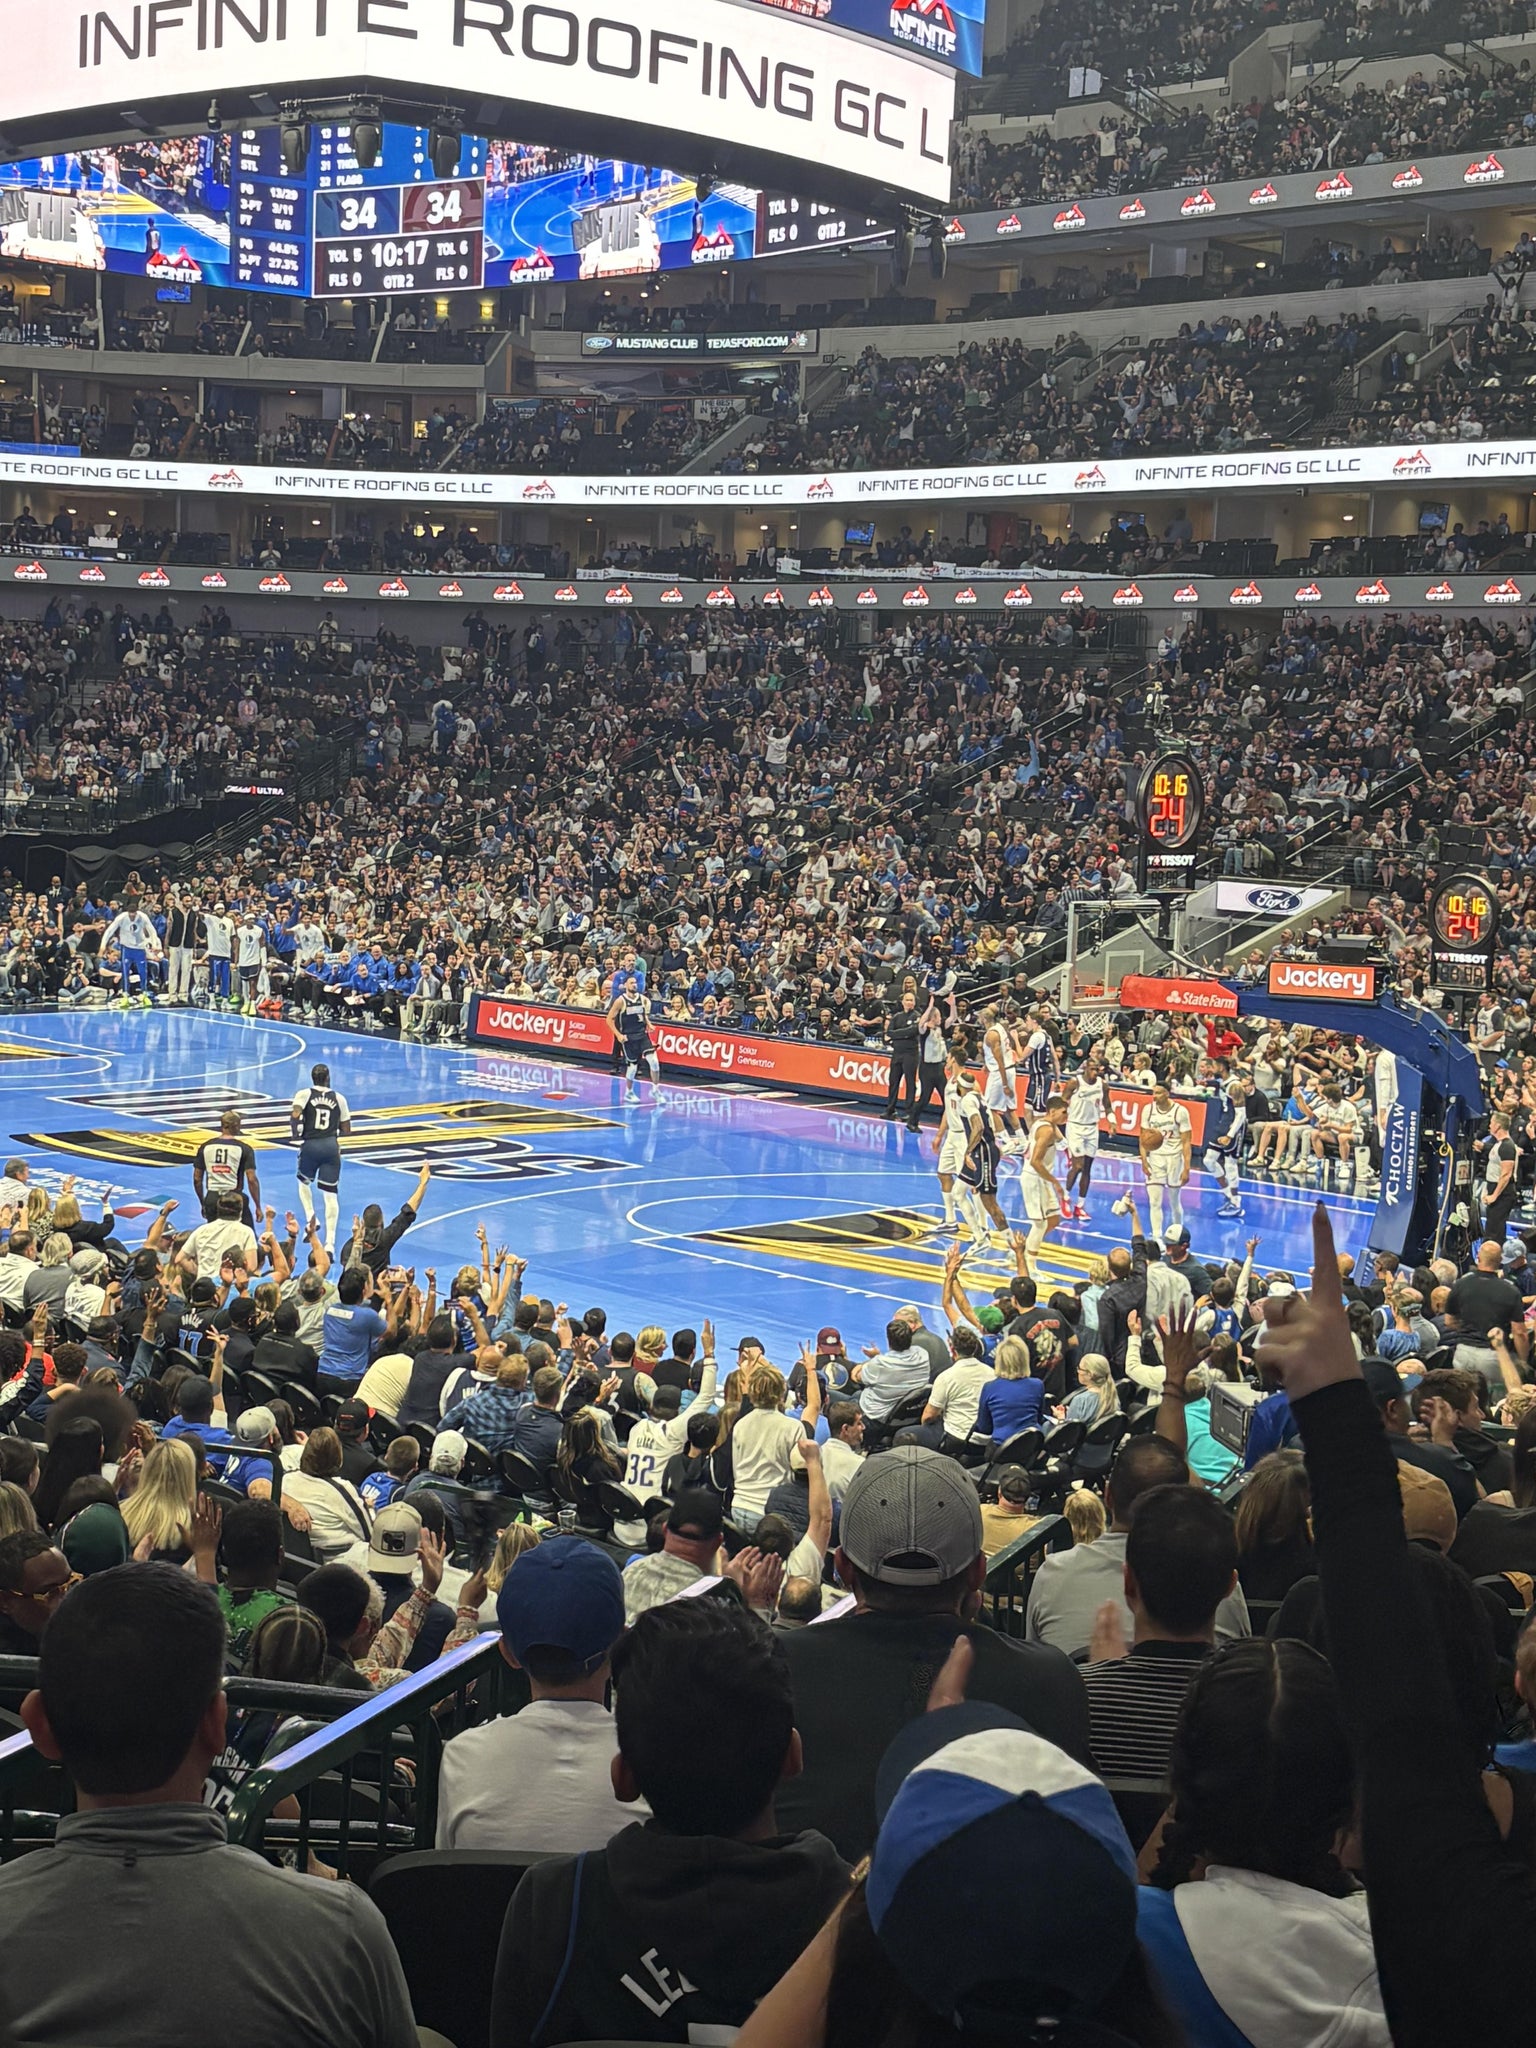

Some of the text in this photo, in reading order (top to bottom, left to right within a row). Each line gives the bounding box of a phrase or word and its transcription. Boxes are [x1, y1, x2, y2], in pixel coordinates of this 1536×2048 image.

[889, 8, 957, 52] INFINITE
[453, 0, 815, 122] ROOFING
[834, 79, 907, 150] GC
[240, 159, 259, 172] STL
[24, 190, 78, 243] THE
[340, 189, 463, 231] 34 34
[768, 199, 787, 217] TOL
[598, 200, 640, 253] THE
[767, 225, 787, 244] FLS
[788, 223, 798, 241] 0
[327, 238, 469, 268] TOL 5 10:17 TOL 6
[328, 272, 349, 288] FLS
[352, 271, 363, 287] 0
[435, 266, 455, 282] FLS
[458, 264, 468, 280] 0
[616, 338, 669, 349] MUSTANG
[669, 338, 699, 349] CLUB
[707, 335, 789, 349] TEXASFORD.COM
[1135, 458, 1361, 481] INFINITE ROOFING GC LLC
[1467, 451, 1536, 467] INFINIT
[30, 463, 112, 479] ROOFING
[116, 467, 141, 480] GC
[145, 469, 178, 481] LLC
[858, 472, 1047, 492] INFINITE ROOFING GC LLC
[274, 474, 493, 494] INFINITE ROOFING GC LLC
[584, 483, 783, 496] INFINITE ROOFING GC LLC
[1154, 774, 1188, 796] 10:16
[1150, 797, 1184, 837] 24
[1160, 855, 1195, 866] TISSOT
[1256, 890, 1291, 909] Ford
[1448, 895, 1487, 916] 10:16
[1448, 915, 1479, 941] 24
[1448, 952, 1488, 964] TISSOT
[1277, 966, 1367, 996] Jackery
[488, 1006, 565, 1043] Jackery
[656, 1029, 735, 1068] Jackery
[314, 1108, 331, 1130] 13
[215, 1148, 228, 1165] 61
[1386, 1101, 1406, 1192] CHOCTAW
[1405, 1153, 1415, 1191] CASINOS
[178, 1328, 203, 1357] 77
[627, 1453, 655, 1487] 32
